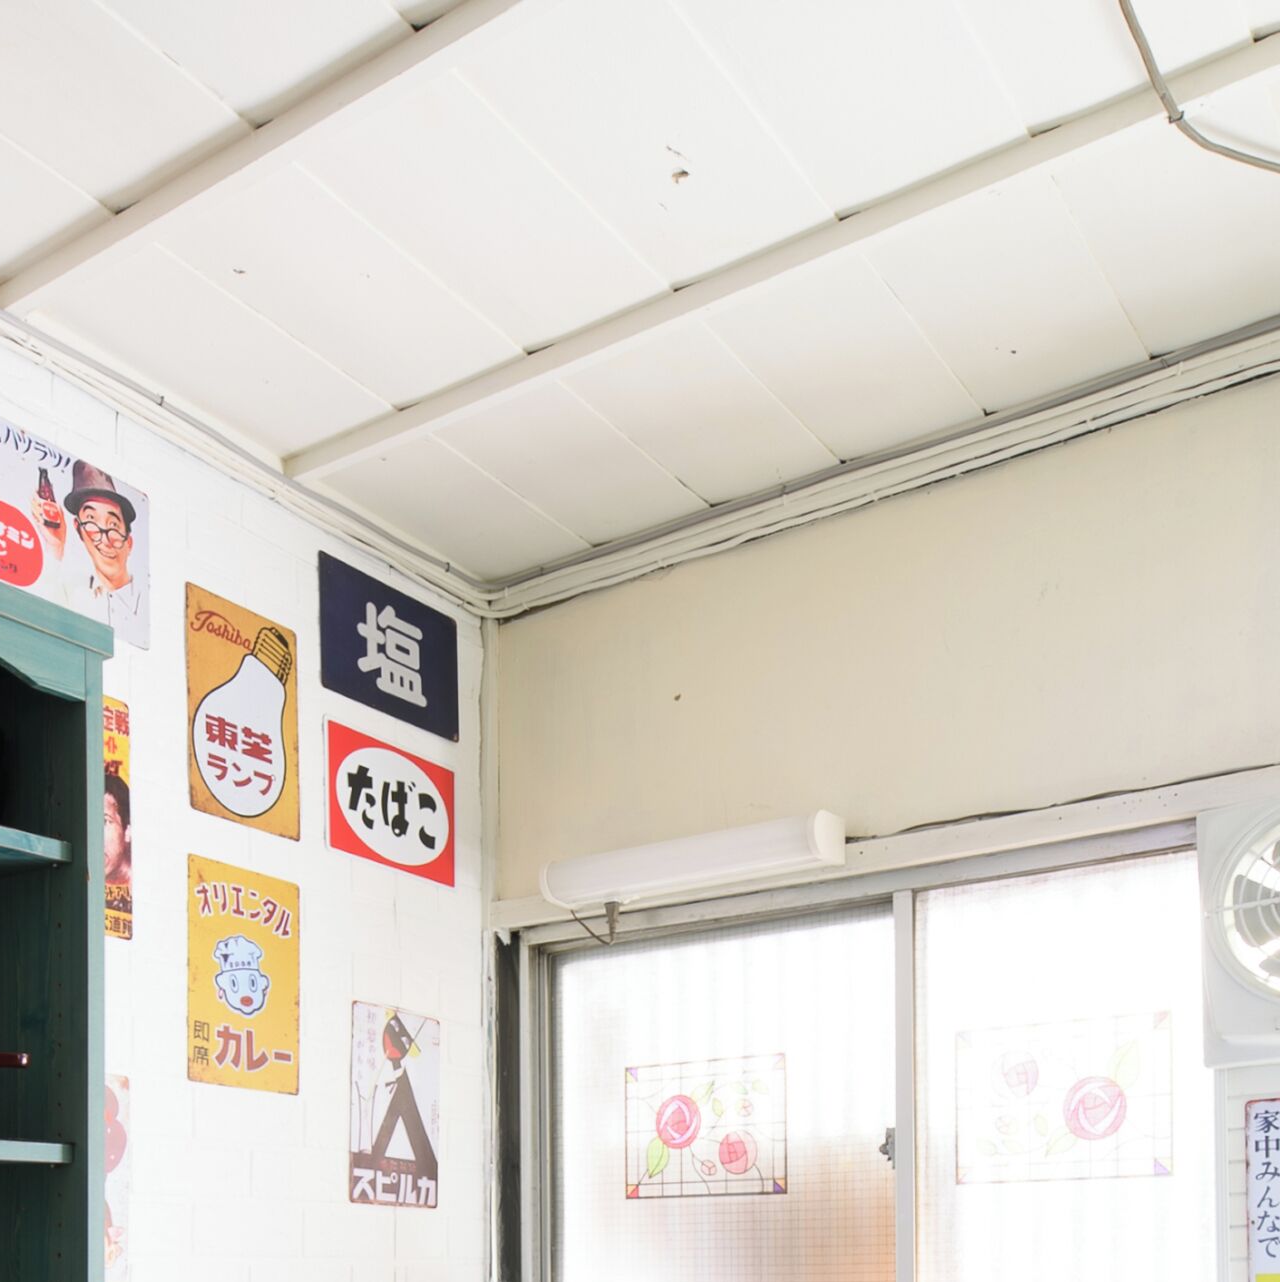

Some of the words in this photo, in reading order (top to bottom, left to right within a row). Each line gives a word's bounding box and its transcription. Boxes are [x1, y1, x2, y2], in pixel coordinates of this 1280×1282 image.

[190, 609, 254, 652] Toshiba
[356, 601, 428, 708] 塩
[205, 713, 274, 765] 東芝
[207, 752, 277, 797] ランプ
[347, 764, 438, 851] たばこ
[196, 884, 291, 938] オリエンタル
[192, 1020, 210, 1067] 即席
[214, 1025, 293, 1072] カレー
